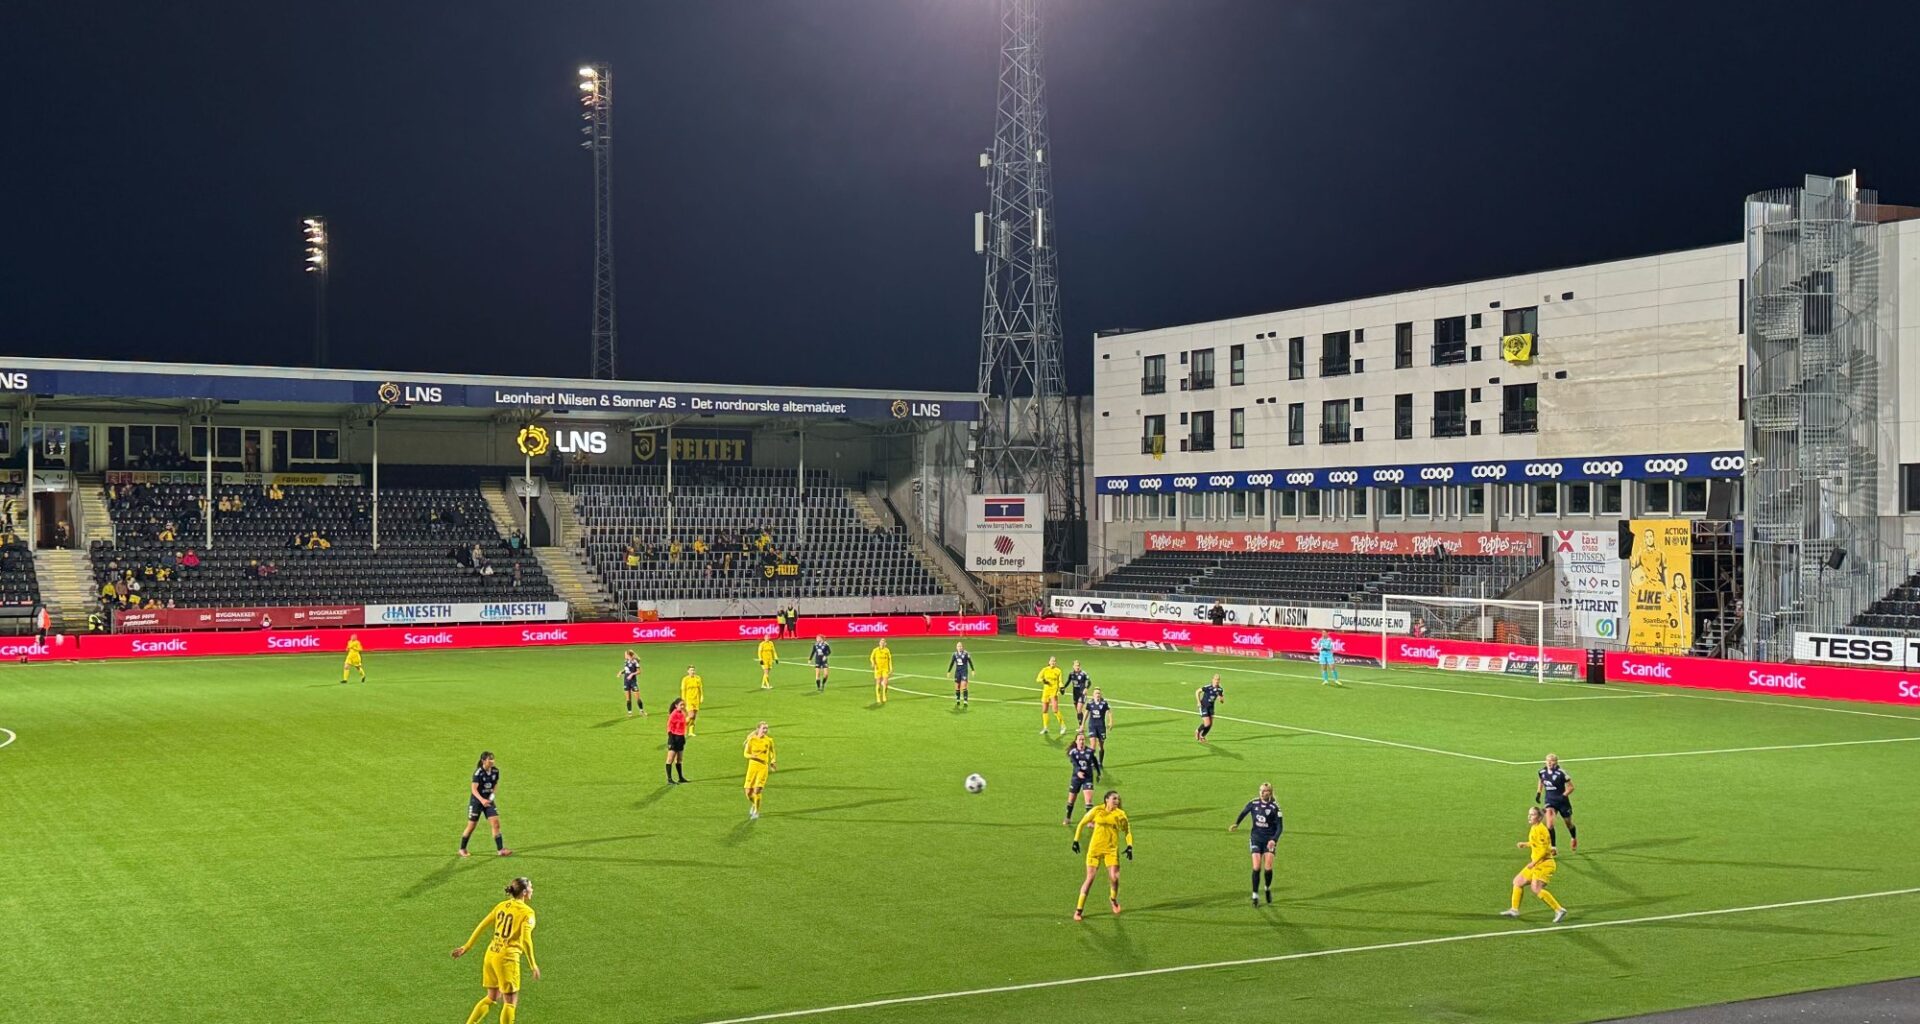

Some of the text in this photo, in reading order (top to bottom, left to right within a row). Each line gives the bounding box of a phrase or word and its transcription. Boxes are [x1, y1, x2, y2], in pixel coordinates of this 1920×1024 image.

[0, 372, 28, 390] NS
[405, 386, 442, 403] LNS
[495, 390, 555, 405] Leonhard
[558, 392, 596, 406] Nilsen
[600, 395, 610, 406] &
[612, 395, 656, 408] Sønner
[658, 397, 676, 409] AS
[691, 398, 713, 410] Det
[715, 399, 780, 412] nordnorske
[782, 400, 846, 414] alternativet
[912, 403, 941, 417] LNS
[555, 430, 607, 454] LNS
[1108, 456, 1744, 491] coop coop coop coop coop coop coop coop coop coop coop coop coop coo
[1000, 504, 1009, 516] T
[1582, 536, 1598, 544] taxi
[1664, 528, 1688, 536] ACTION
[1151, 534, 1171, 550] Peppes
[1196, 534, 1218, 551] Peppes
[1244, 534, 1268, 552] Peppes
[1296, 534, 1320, 552] Peppes
[1350, 534, 1379, 554] Peppes
[1412, 536, 1442, 555] Peppes
[1478, 535, 1510, 556] Peppes
[1664, 536, 1688, 546] NOW
[976, 556, 1025, 568] Bodø Energi
[1570, 564, 1605, 574] CONSULT
[1637, 590, 1662, 604] LIKE
[386, 606, 452, 618] HANESETH
[484, 604, 546, 616] HANESETH
[1158, 602, 1182, 618] elfag
[1197, 604, 1236, 622] Elero
[1274, 607, 1308, 626] NILSSON
[1340, 613, 1404, 628] DUGADSKAFE.NO
[0, 620, 990, 660] candic Scandic Scandic Scandic Scandic Scandic Scandic Scandic Scandic
[1034, 622, 1059, 634] Scandic
[1094, 625, 1120, 637] Scandic
[1162, 628, 1191, 640] Scandic
[1232, 632, 1264, 646] Scandic
[1311, 638, 1346, 652] Scdic
[1401, 644, 1441, 659] Scandic
[1808, 636, 1893, 662] TESS
[1622, 660, 1920, 698] Scandic Scandic Sc
[497, 910, 514, 938] 20
